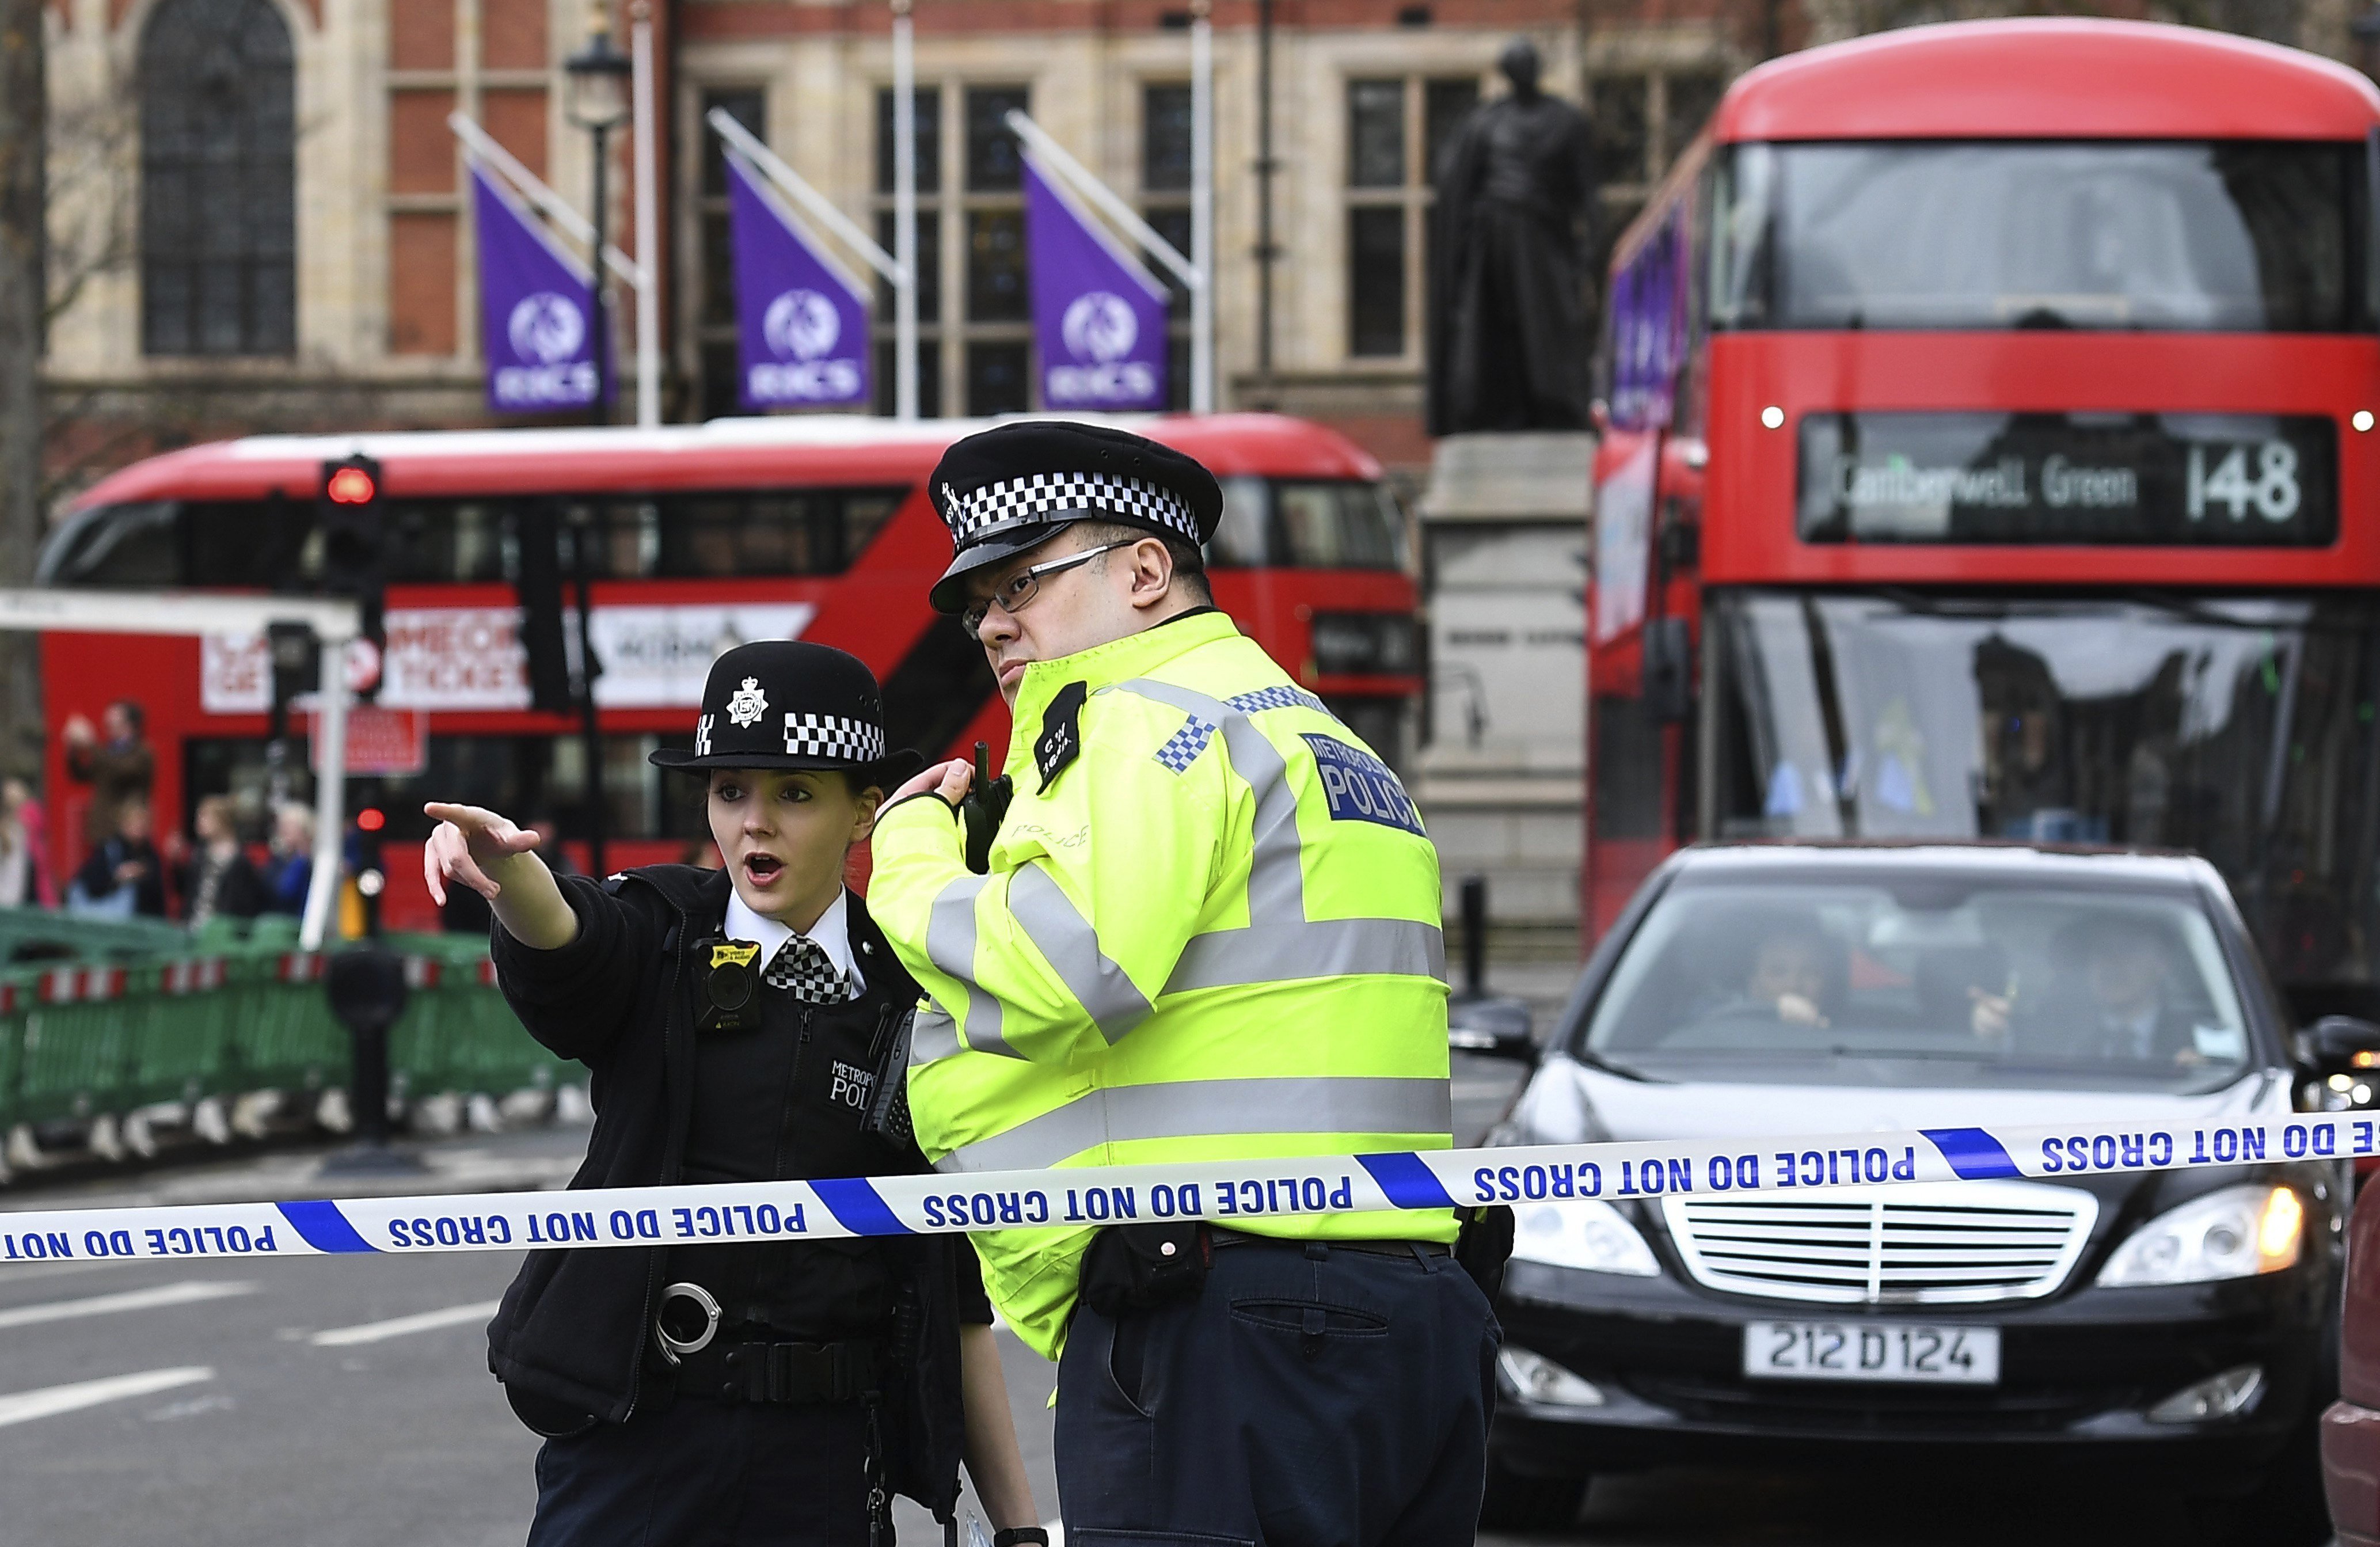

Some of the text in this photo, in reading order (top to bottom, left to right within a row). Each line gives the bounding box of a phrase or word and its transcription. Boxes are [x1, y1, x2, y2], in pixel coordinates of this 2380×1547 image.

[747, 358, 861, 402] RICS
[1047, 361, 1155, 403] RICS
[2041, 454, 2137, 508] Green
[2187, 439, 2301, 521] 148
[830, 1077, 867, 1111] POL
[831, 1059, 877, 1087] METROPO
[2041, 1131, 2173, 1172] CROSS
[2188, 1127, 2265, 1164] NOT
[2283, 1123, 2336, 1158] DO
[1474, 1146, 1915, 1202] POLICE DO NOT CROSS
[923, 1176, 1352, 1226] POLICE DO NOT CROSS
[5, 1224, 277, 1259] POLICE DO NOT
[389, 1203, 807, 1247] POLICE DO NOT CROSS
[1771, 1326, 1974, 1373] 212 D 124
